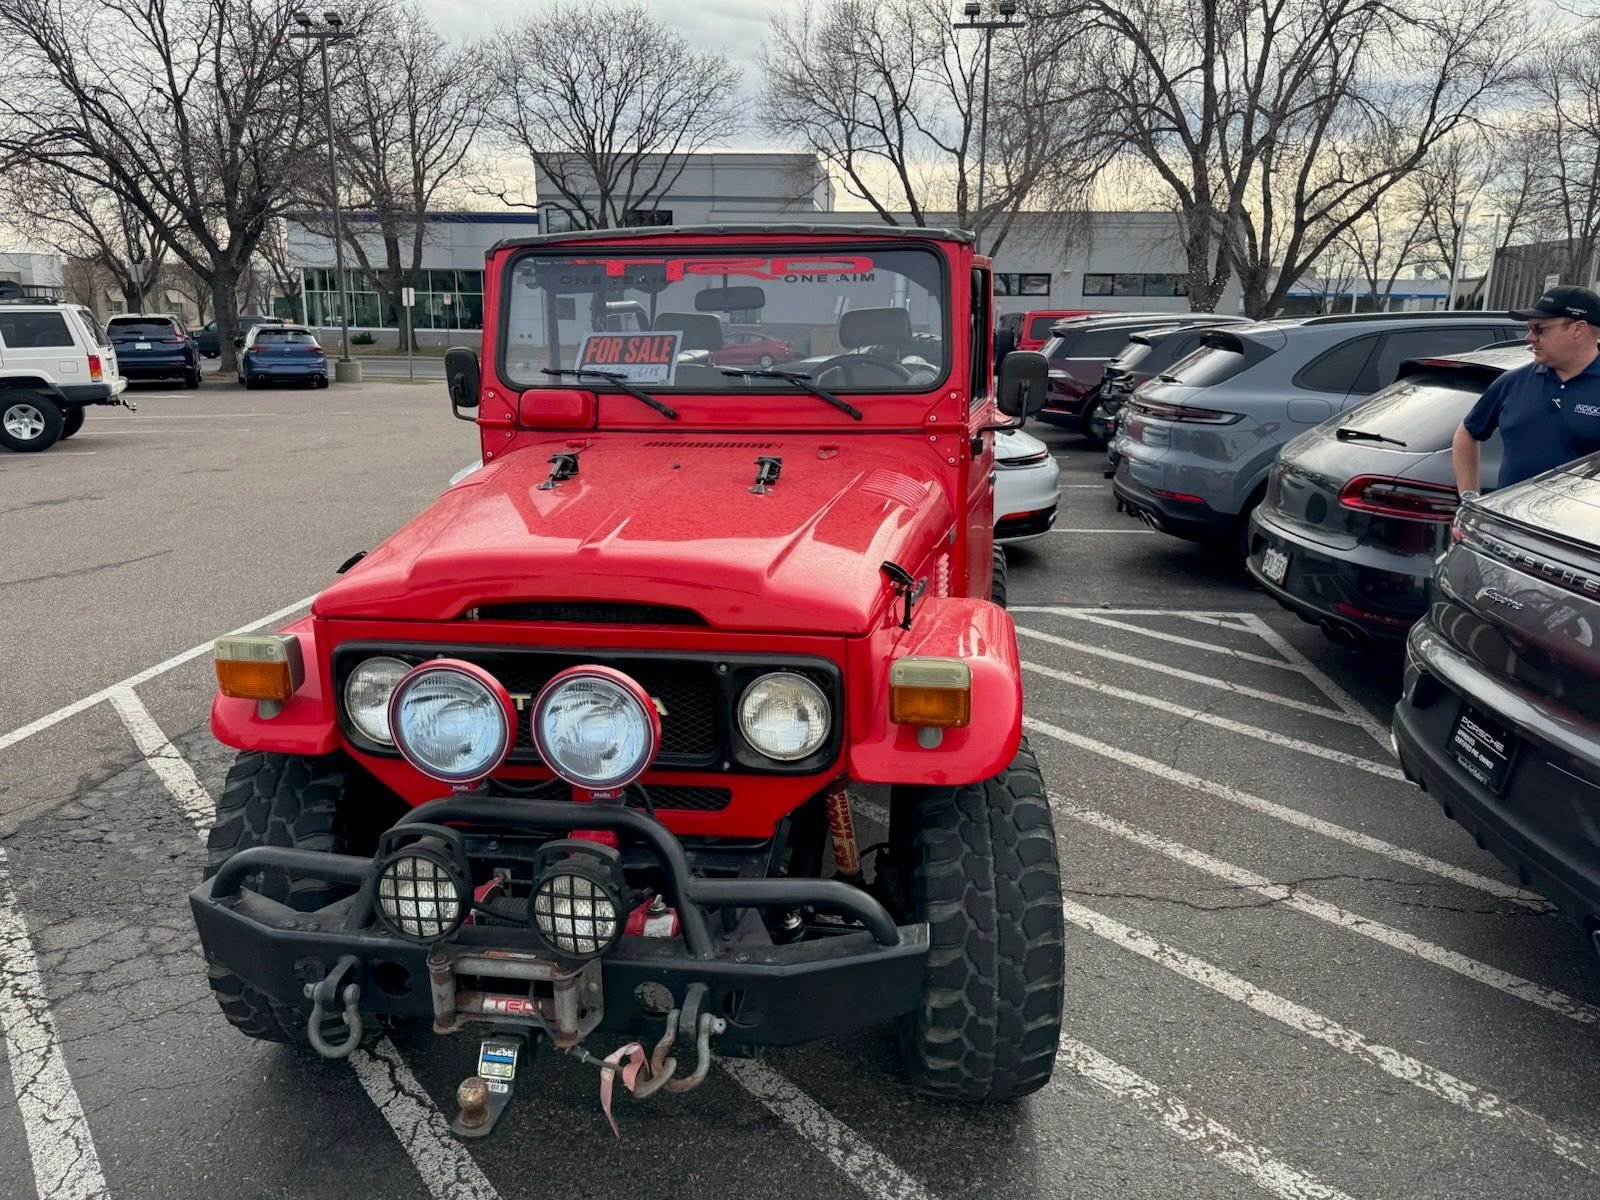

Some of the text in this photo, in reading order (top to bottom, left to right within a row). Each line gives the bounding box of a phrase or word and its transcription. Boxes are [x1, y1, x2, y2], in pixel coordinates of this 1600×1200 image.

[559, 275, 602, 285] ONE
[568, 256, 874, 281] TRD
[783, 273, 875, 284] ONE AIM
[584, 336, 673, 364] FOR SALE
[1480, 538, 1600, 594] PORSCHE
[1461, 715, 1505, 752] PORSCHE
